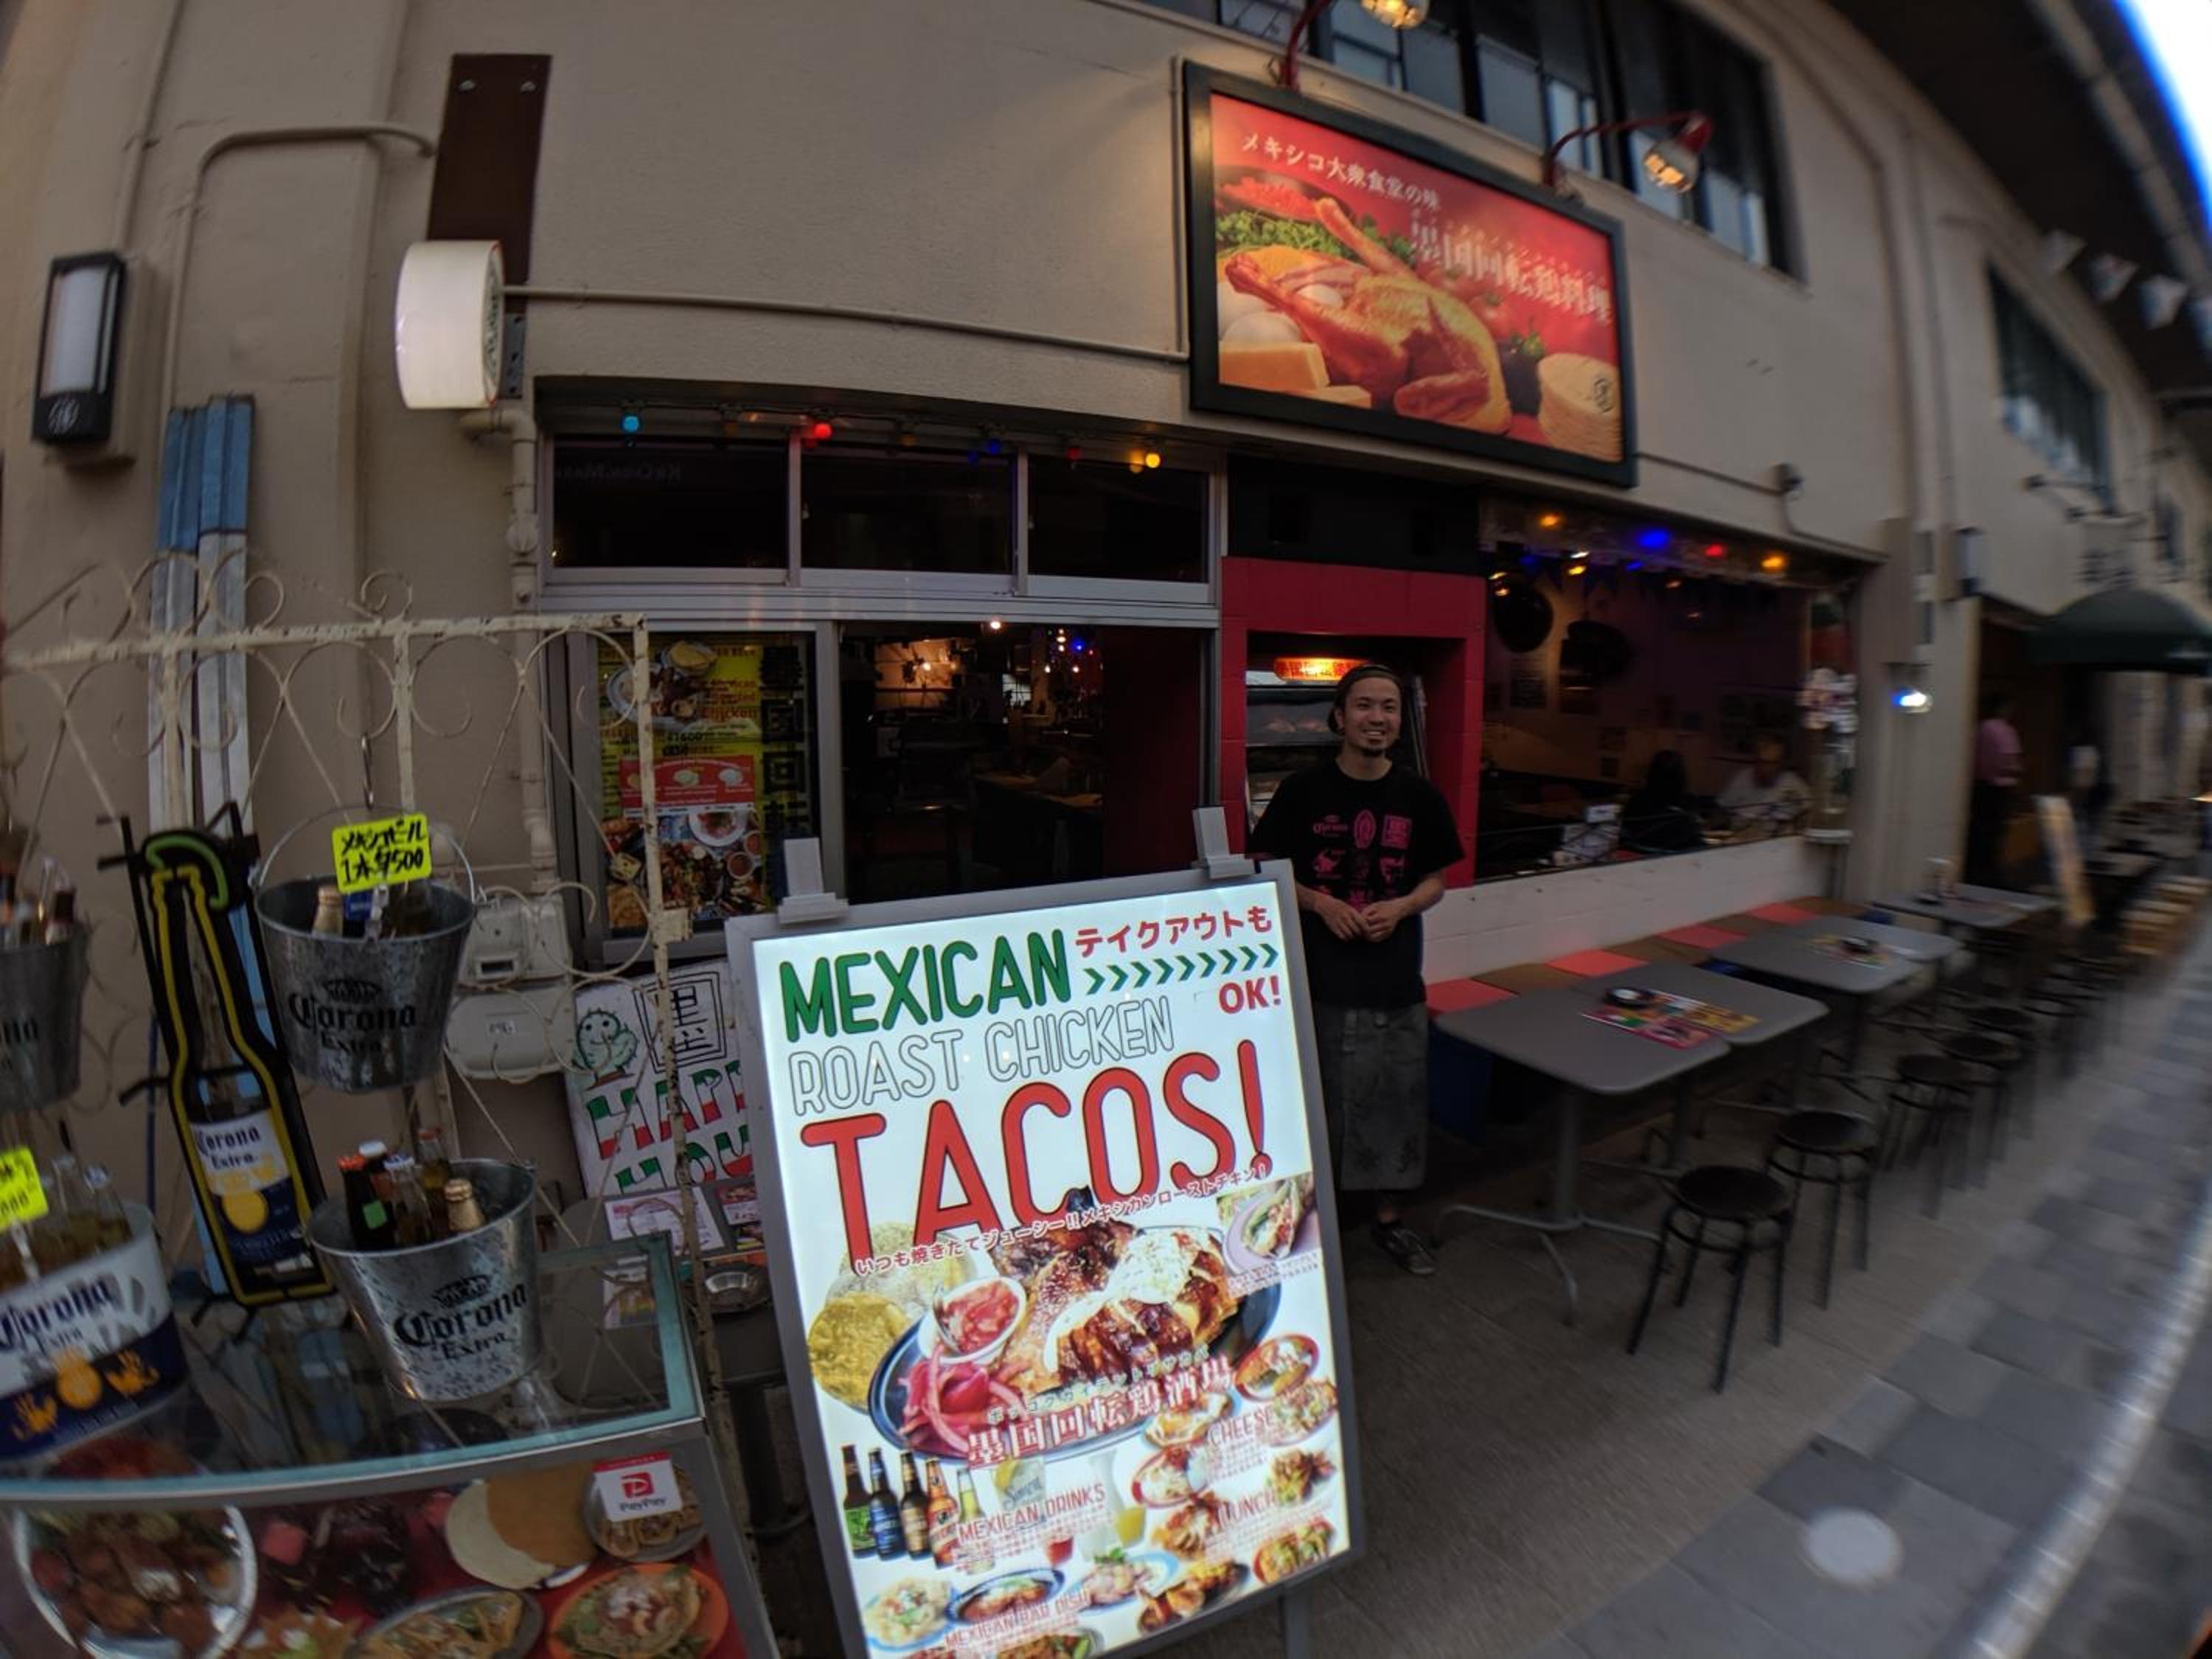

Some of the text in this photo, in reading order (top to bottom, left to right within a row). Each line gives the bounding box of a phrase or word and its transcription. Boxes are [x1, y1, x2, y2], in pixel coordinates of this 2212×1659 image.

[1242, 132, 1441, 212] メキシコ大衆食堂の味
[1076, 905, 1273, 959] テイクアウトも
[288, 992, 416, 1034] Corona
[779, 929, 1072, 1043] MEXICAN
[1219, 973, 1281, 1014] OK!
[788, 995, 1175, 1116] ROAST CHICKEN
[196, 1126, 260, 1157] Corona
[800, 1038, 1274, 1275] TACOS!
[394, 1284, 526, 1347] Corona
[967, 1354, 1234, 1470] 墨国回転鶏酒場
[619, 1497, 667, 1512] PayPay
[956, 1503, 1039, 1543] MEXICAN
[1045, 1482, 1106, 1517] DRINKS
